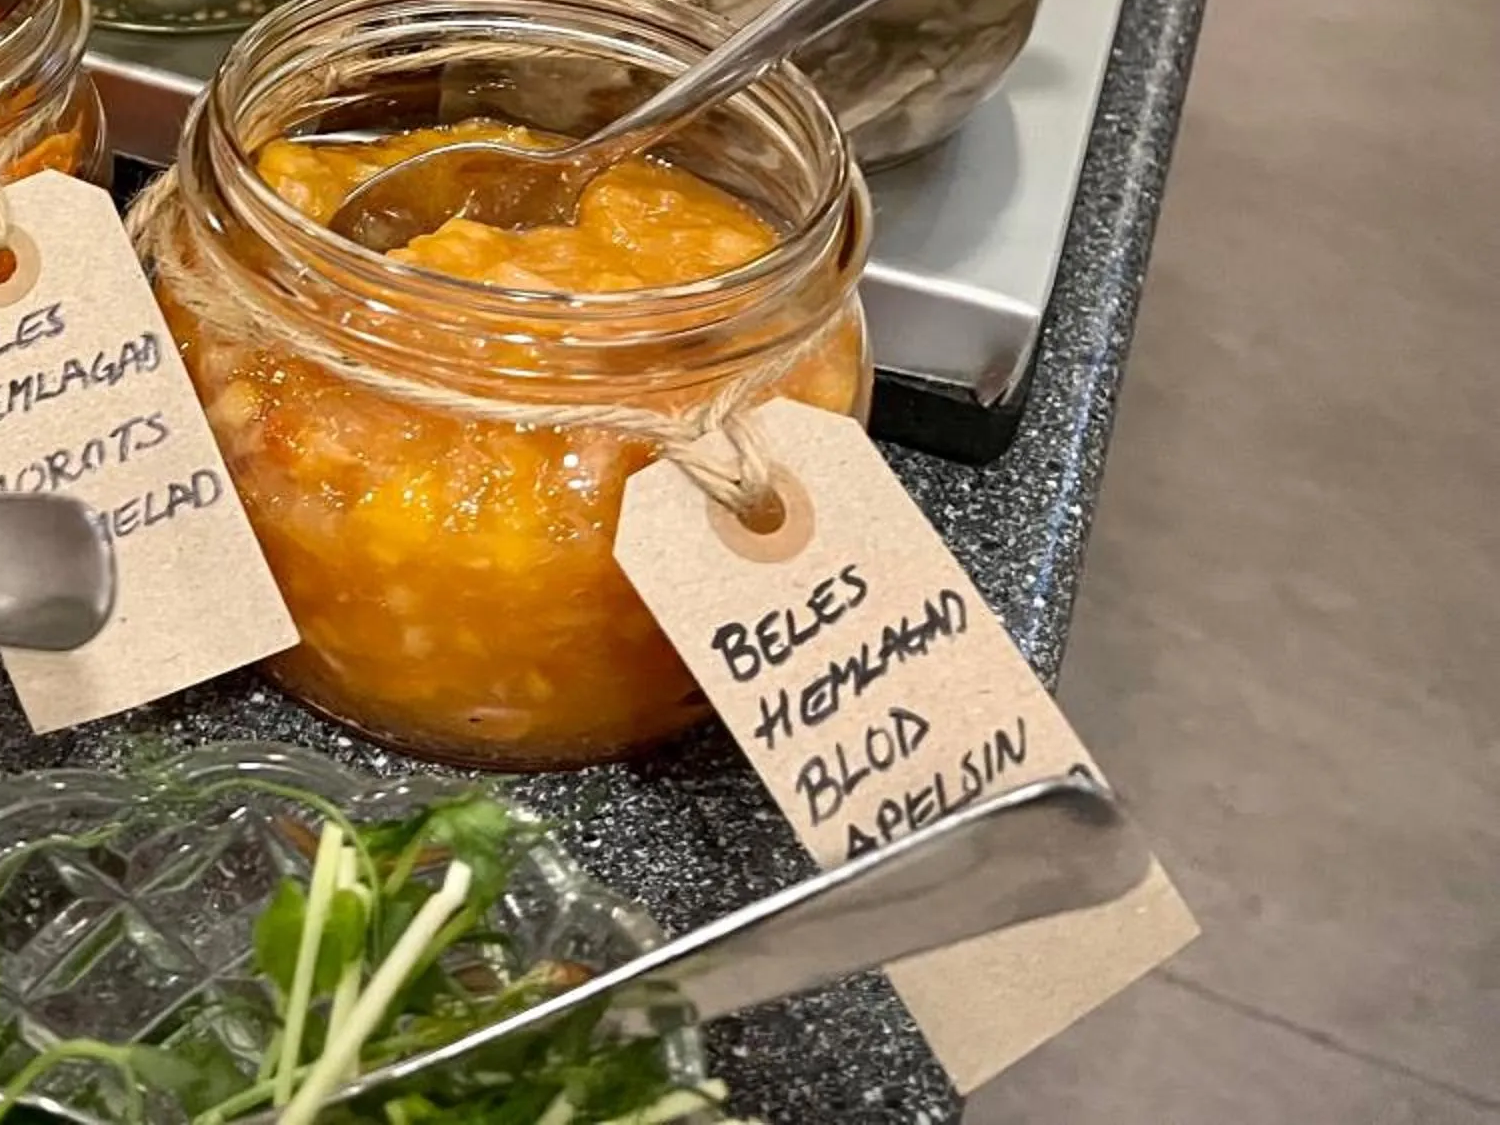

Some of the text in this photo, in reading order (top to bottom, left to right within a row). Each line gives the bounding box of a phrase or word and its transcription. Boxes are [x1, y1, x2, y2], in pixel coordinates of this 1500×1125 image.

[710, 563, 869, 682] BELES
[794, 706, 931, 828] BLOD
[846, 715, 1027, 861] APELSIN
